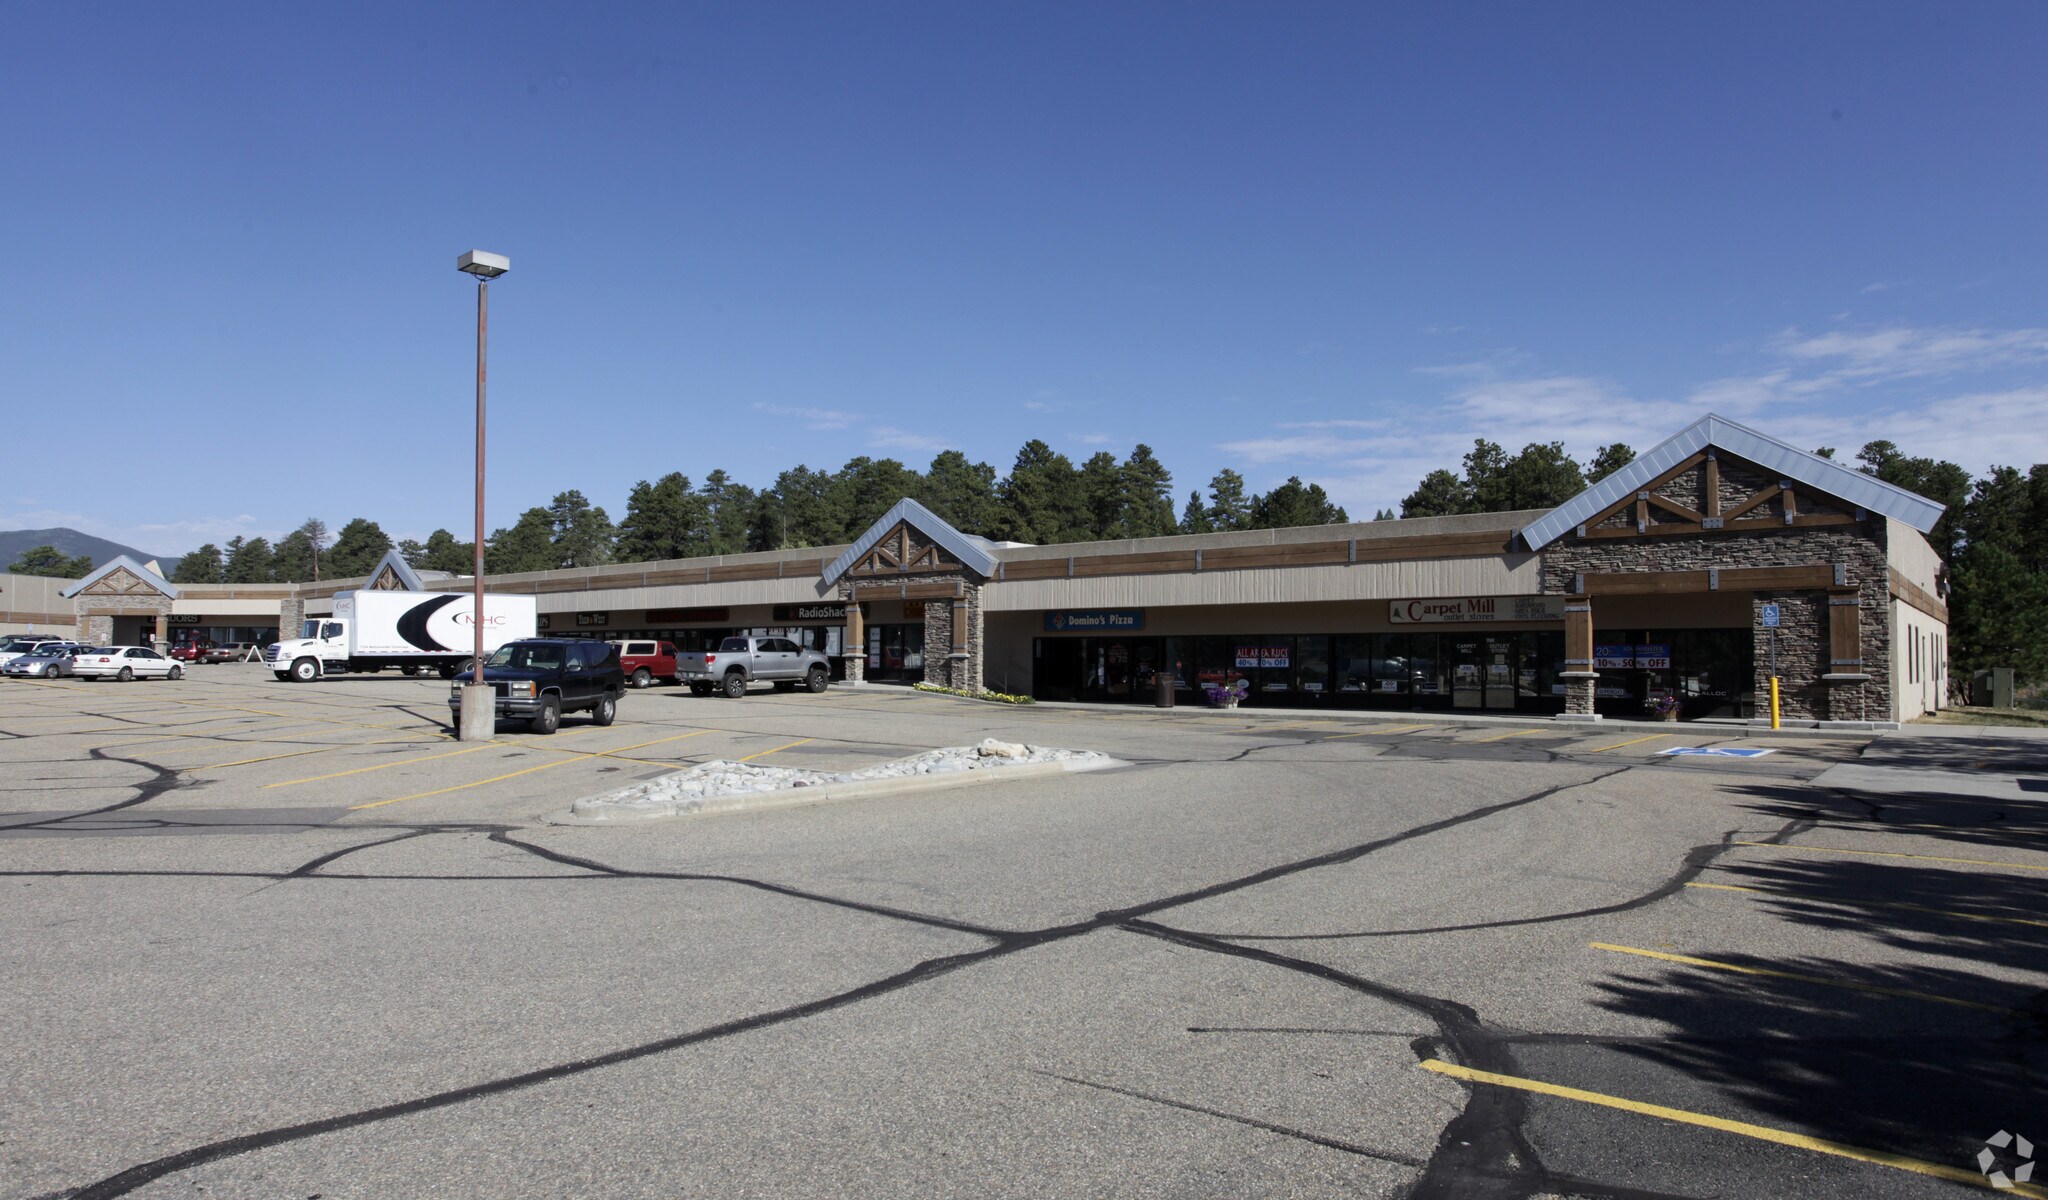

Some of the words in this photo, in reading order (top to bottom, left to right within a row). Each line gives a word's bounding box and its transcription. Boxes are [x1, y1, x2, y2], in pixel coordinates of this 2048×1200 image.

[799, 606, 848, 619] RadioShac
[1408, 600, 1462, 621] Carpet
[1468, 598, 1495, 613] Mill
[1068, 615, 1106, 625] Domino's
[1110, 613, 1134, 624] Pizza
[1444, 613, 1464, 621] outlet
[1470, 612, 1496, 620] stores
[1236, 648, 1249, 657] ALL
[1250, 648, 1270, 657] AREA
[1271, 648, 1288, 658] RUGS
[1596, 647, 1609, 656] 20
[1597, 659, 1616, 667] 10%
[1648, 659, 1666, 667] OFF
